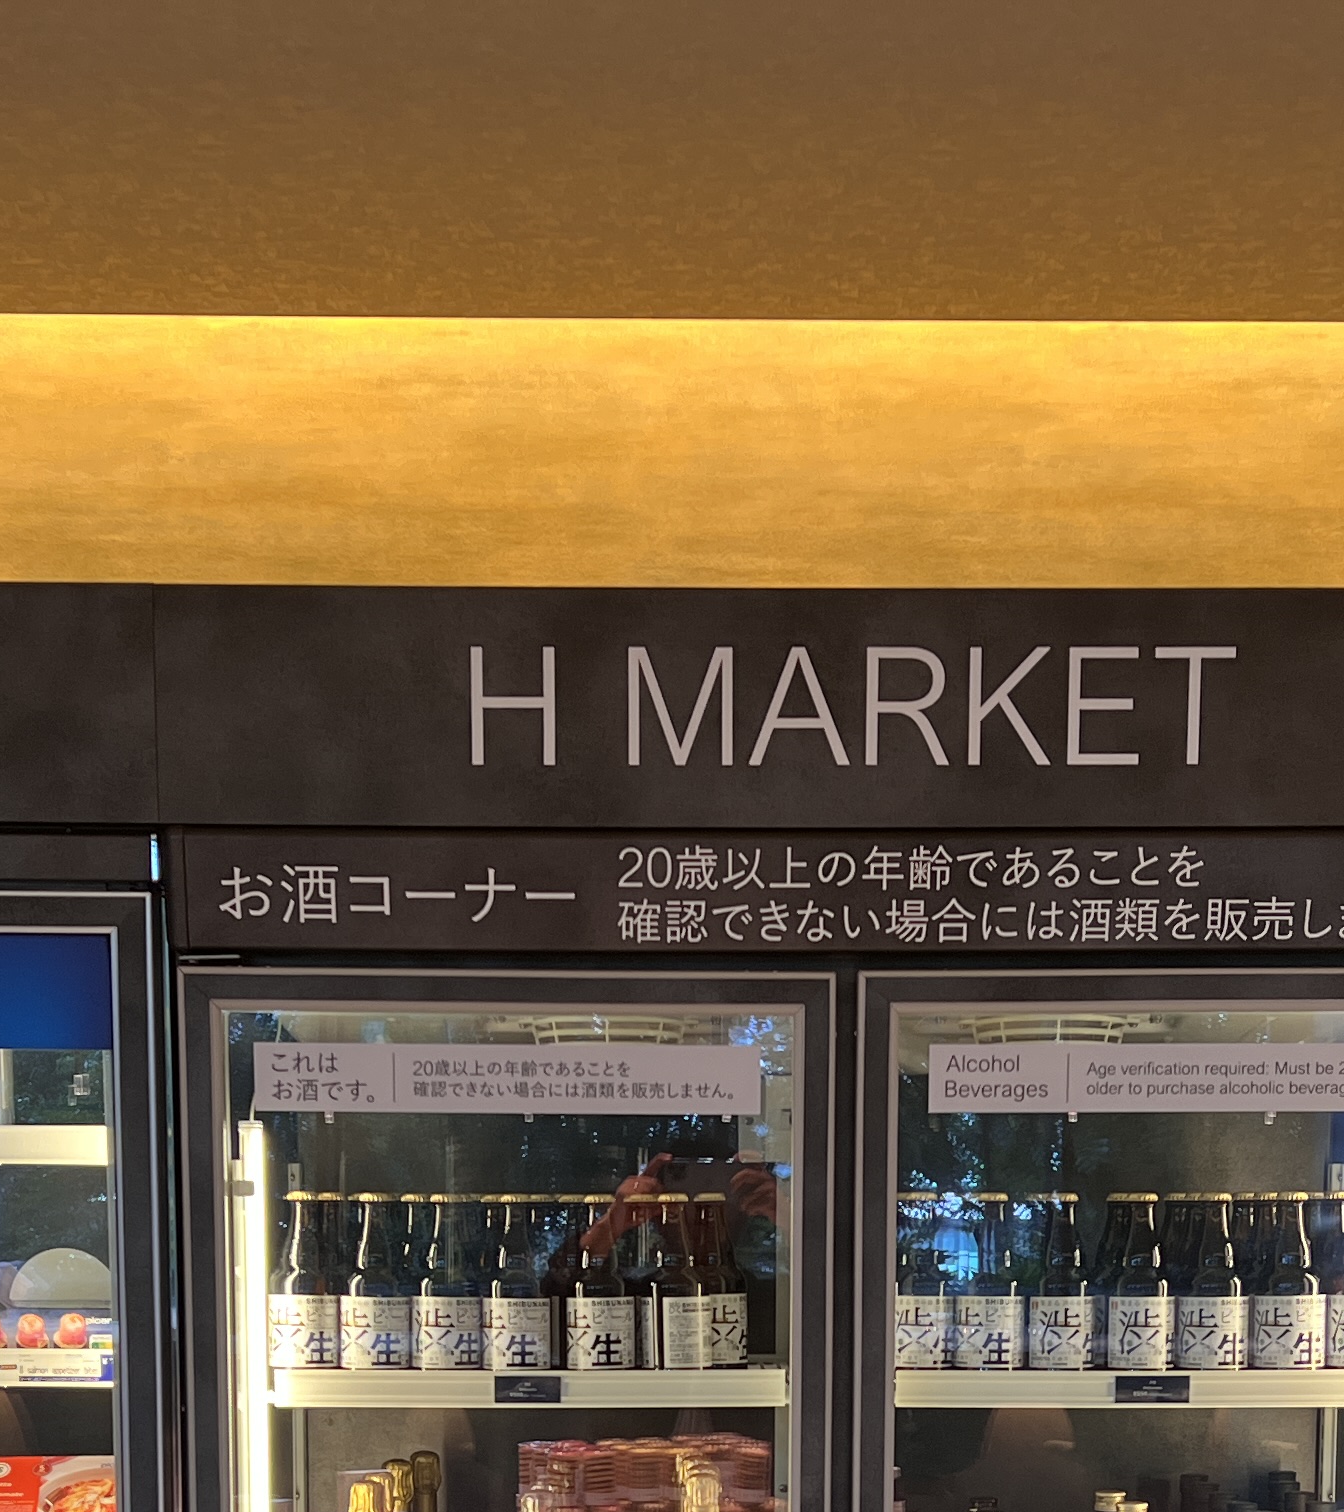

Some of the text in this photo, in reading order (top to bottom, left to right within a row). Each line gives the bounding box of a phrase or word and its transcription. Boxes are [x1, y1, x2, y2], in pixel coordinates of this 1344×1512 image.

[470, 645, 1238, 766] H MARKET
[616, 846, 1205, 890] 20歳以上の年齢であることを
[217, 861, 576, 924] お酒コーナー
[271, 1052, 338, 1073] これは
[413, 1060, 631, 1077] 20歳以上の年齢であることを
[946, 1055, 1020, 1074] Alcohol
[1086, 1062, 1116, 1078] Age
[1121, 1061, 1200, 1076] verification
[1205, 1061, 1270, 1078] required:
[1274, 1061, 1311, 1076] Must
[1316, 1061, 1334, 1075] be
[272, 1080, 375, 1103] お酒です。
[413, 1081, 734, 1099] 確認できない場合には酒類を販売しません。
[944, 1080, 1049, 1099] Beverages
[1086, 1081, 1122, 1096] older
[1127, 1082, 1142, 1096] to
[1147, 1082, 1214, 1099] purchase
[1219, 1081, 1284, 1096] alcoholic
[306, 1331, 334, 1364] 生
[371, 1333, 401, 1365] 生
[506, 1333, 538, 1366] 生
[590, 1333, 623, 1367] 生
